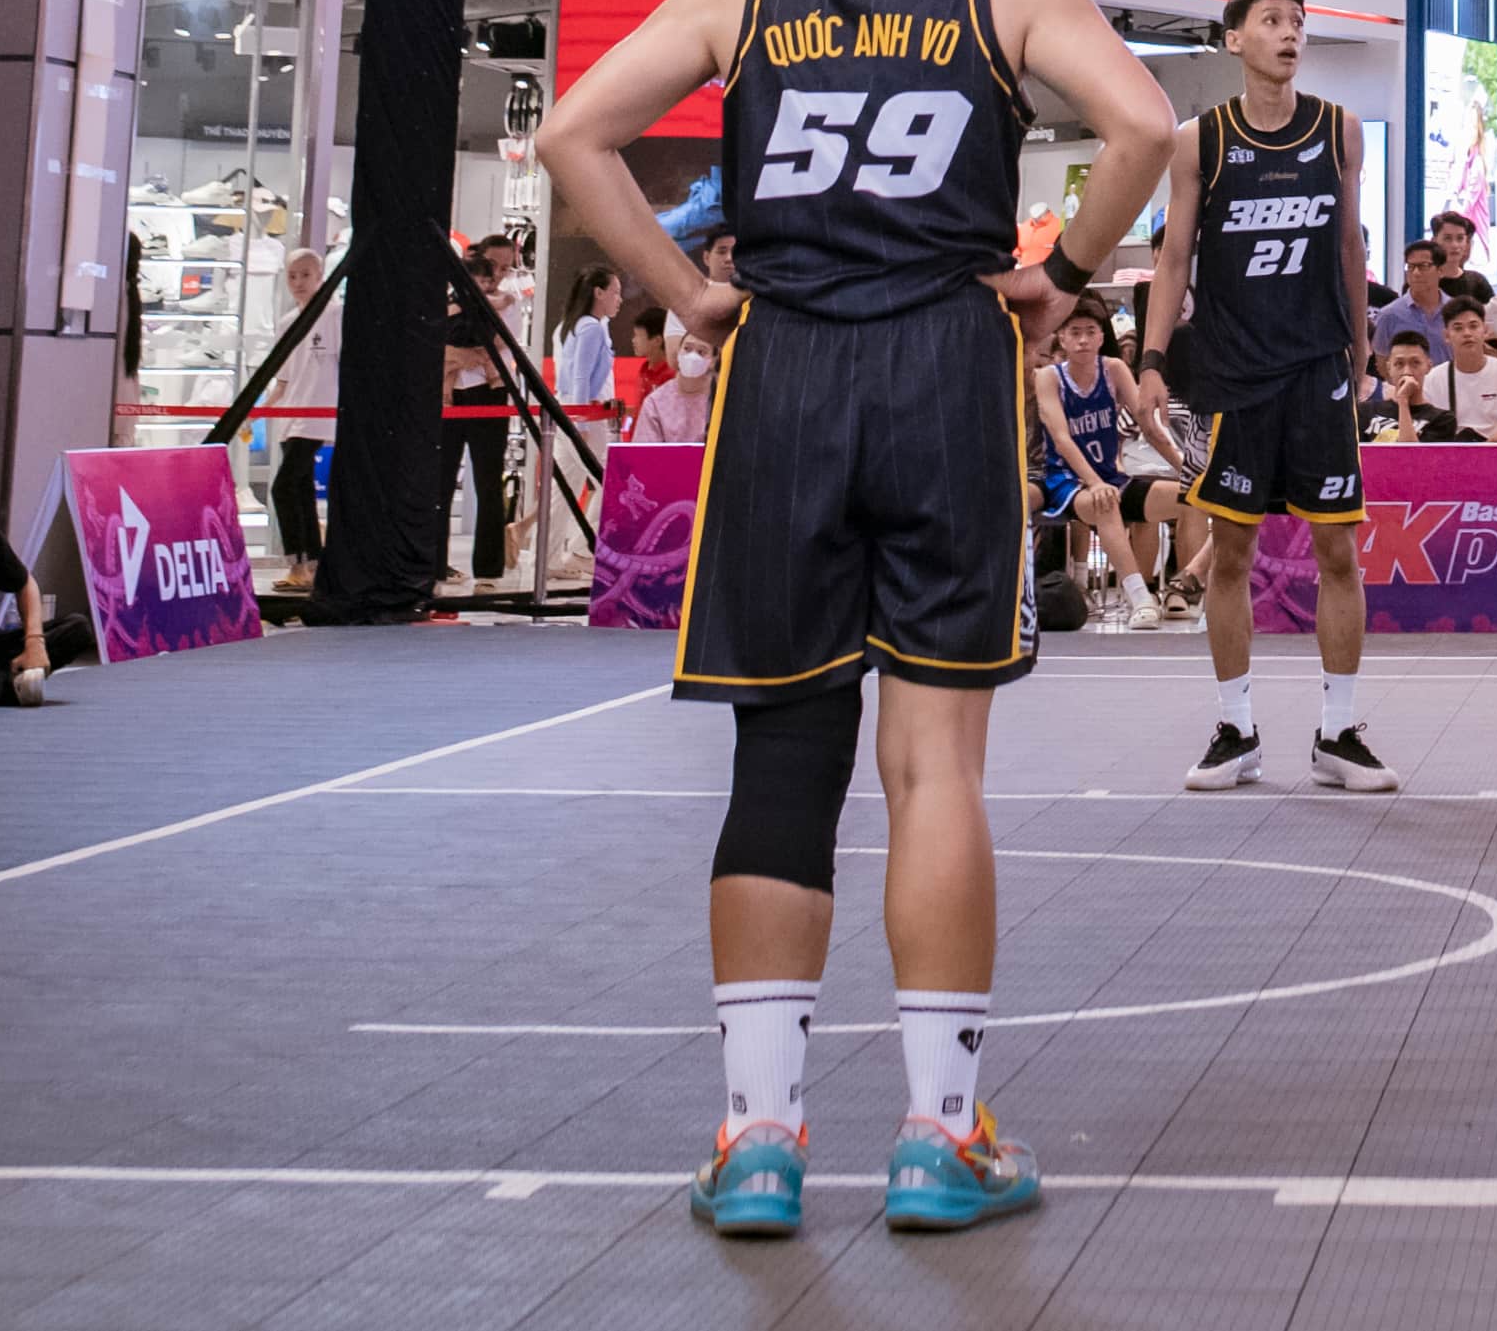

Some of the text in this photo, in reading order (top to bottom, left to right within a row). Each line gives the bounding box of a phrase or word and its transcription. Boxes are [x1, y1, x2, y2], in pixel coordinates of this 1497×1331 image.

[763, 10, 960, 69] QUỐC ANH VÕ
[753, 90, 974, 201] 59
[1221, 195, 1337, 233] 3BBC
[1245, 237, 1310, 277] 21
[1318, 474, 1356, 500] 21
[154, 538, 230, 602] DELTA
